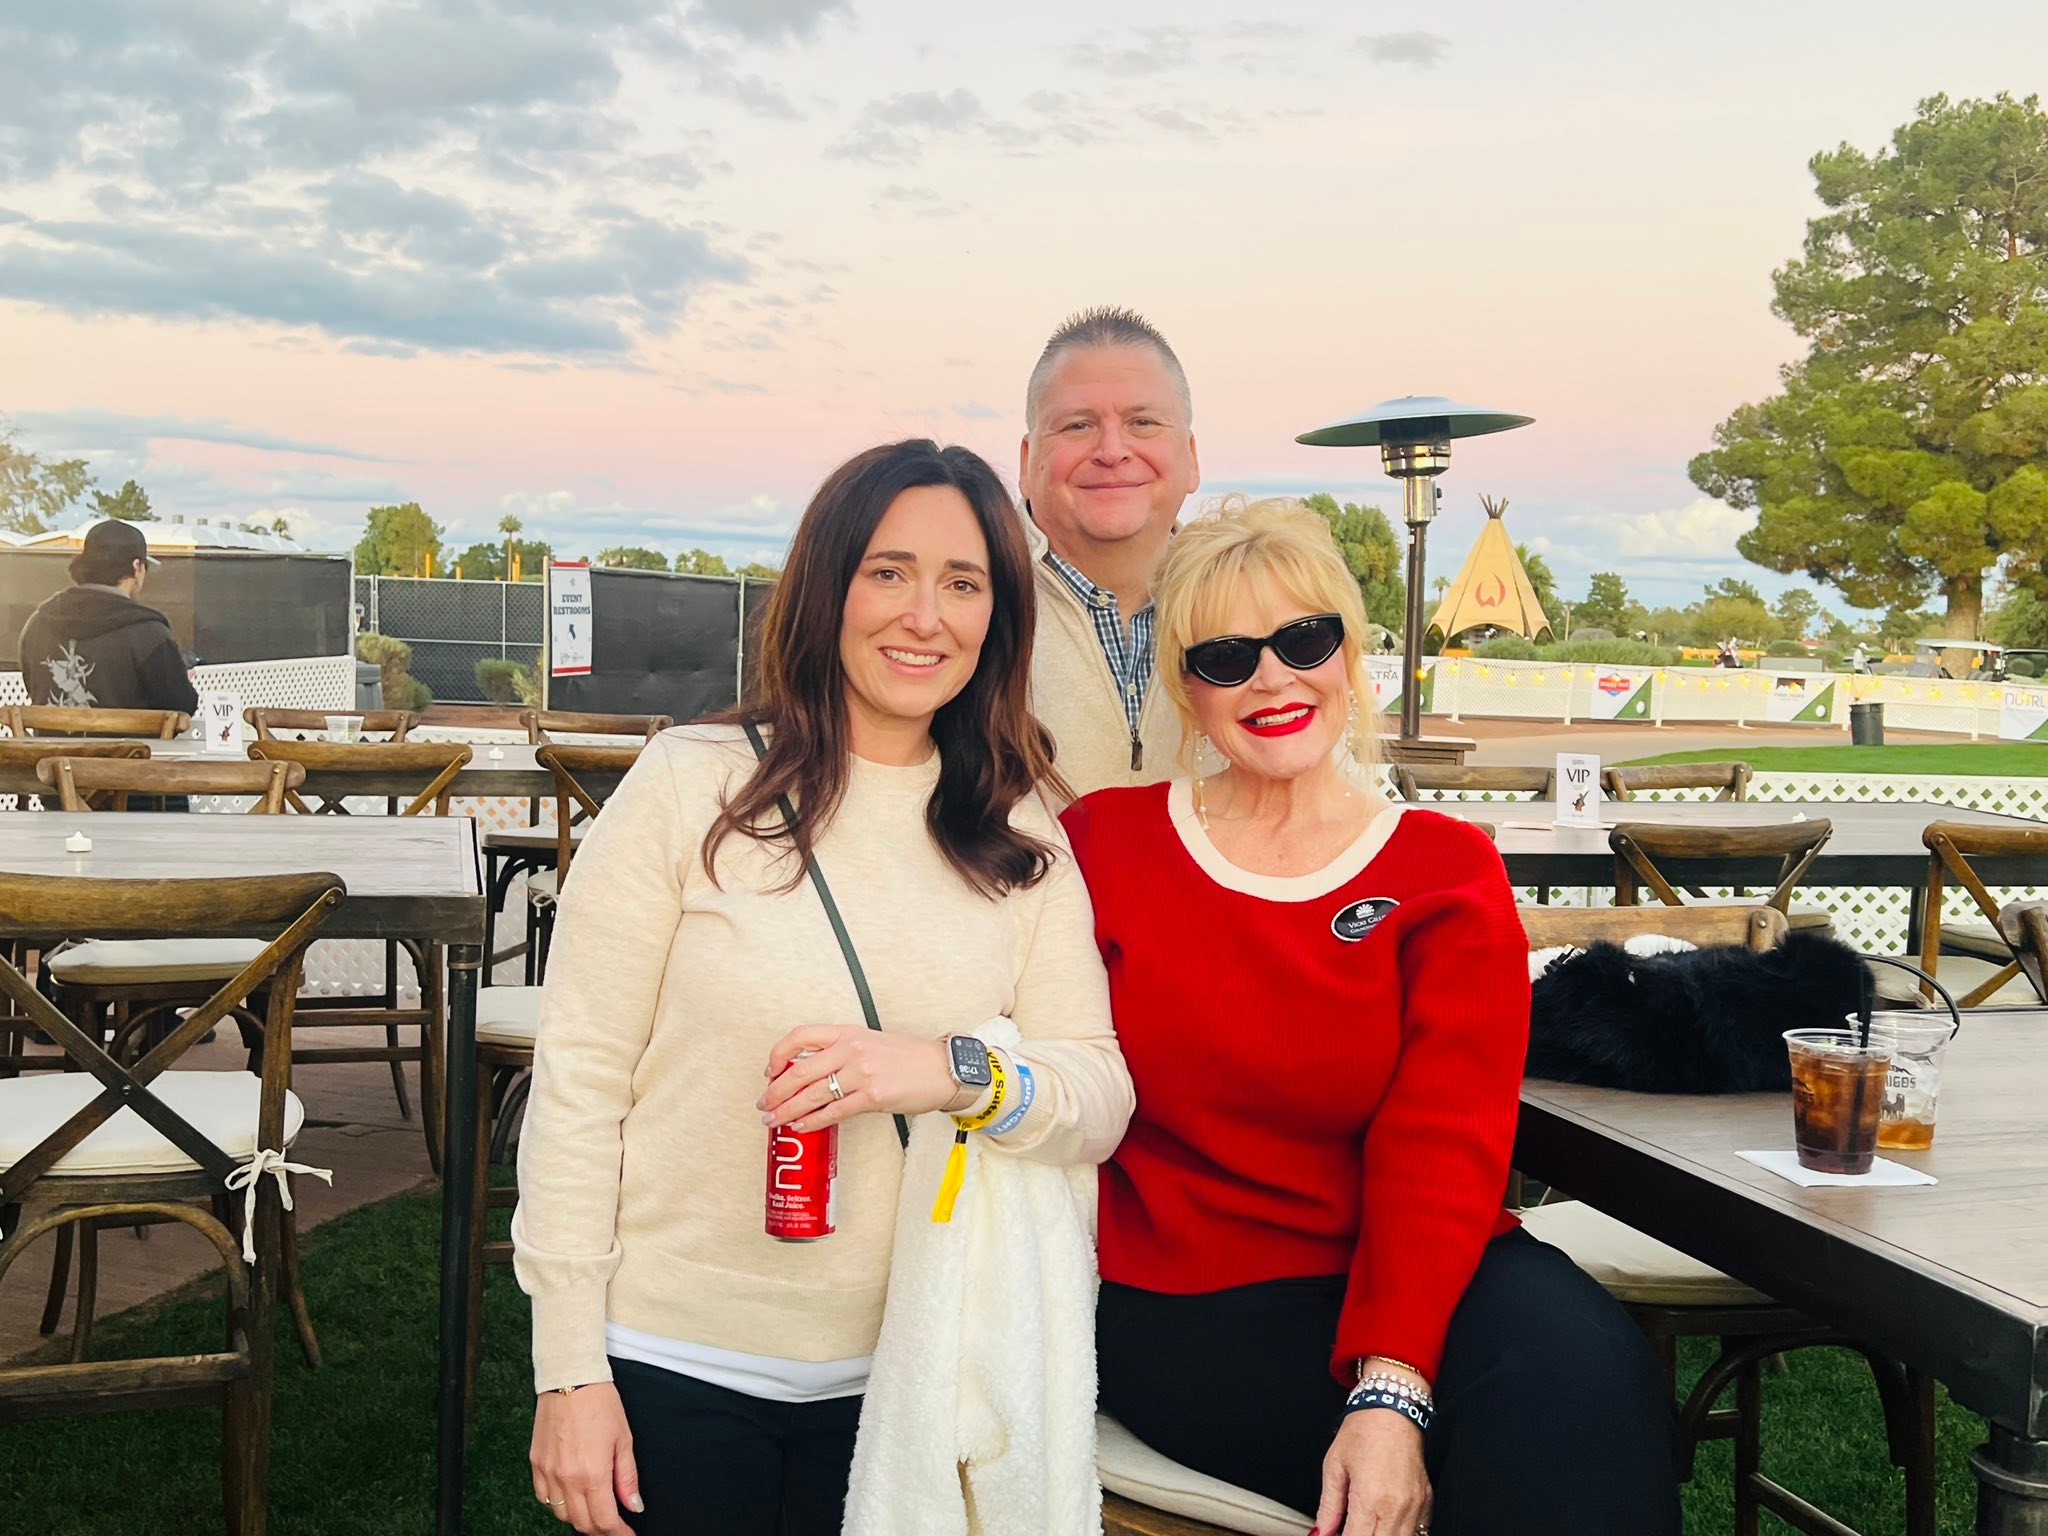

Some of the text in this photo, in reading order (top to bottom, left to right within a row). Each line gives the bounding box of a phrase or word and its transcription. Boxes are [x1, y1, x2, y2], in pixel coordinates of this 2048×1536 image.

[562, 594, 582, 603] EVENT
[553, 606, 591, 615] RESTROOMS
[1369, 672, 1399, 681] LTRA
[213, 703, 234, 717] VIP
[1566, 767, 1591, 783] VIP
[976, 1051, 1005, 1121] VIP Suites
[1023, 1076, 1032, 1106] BUD
